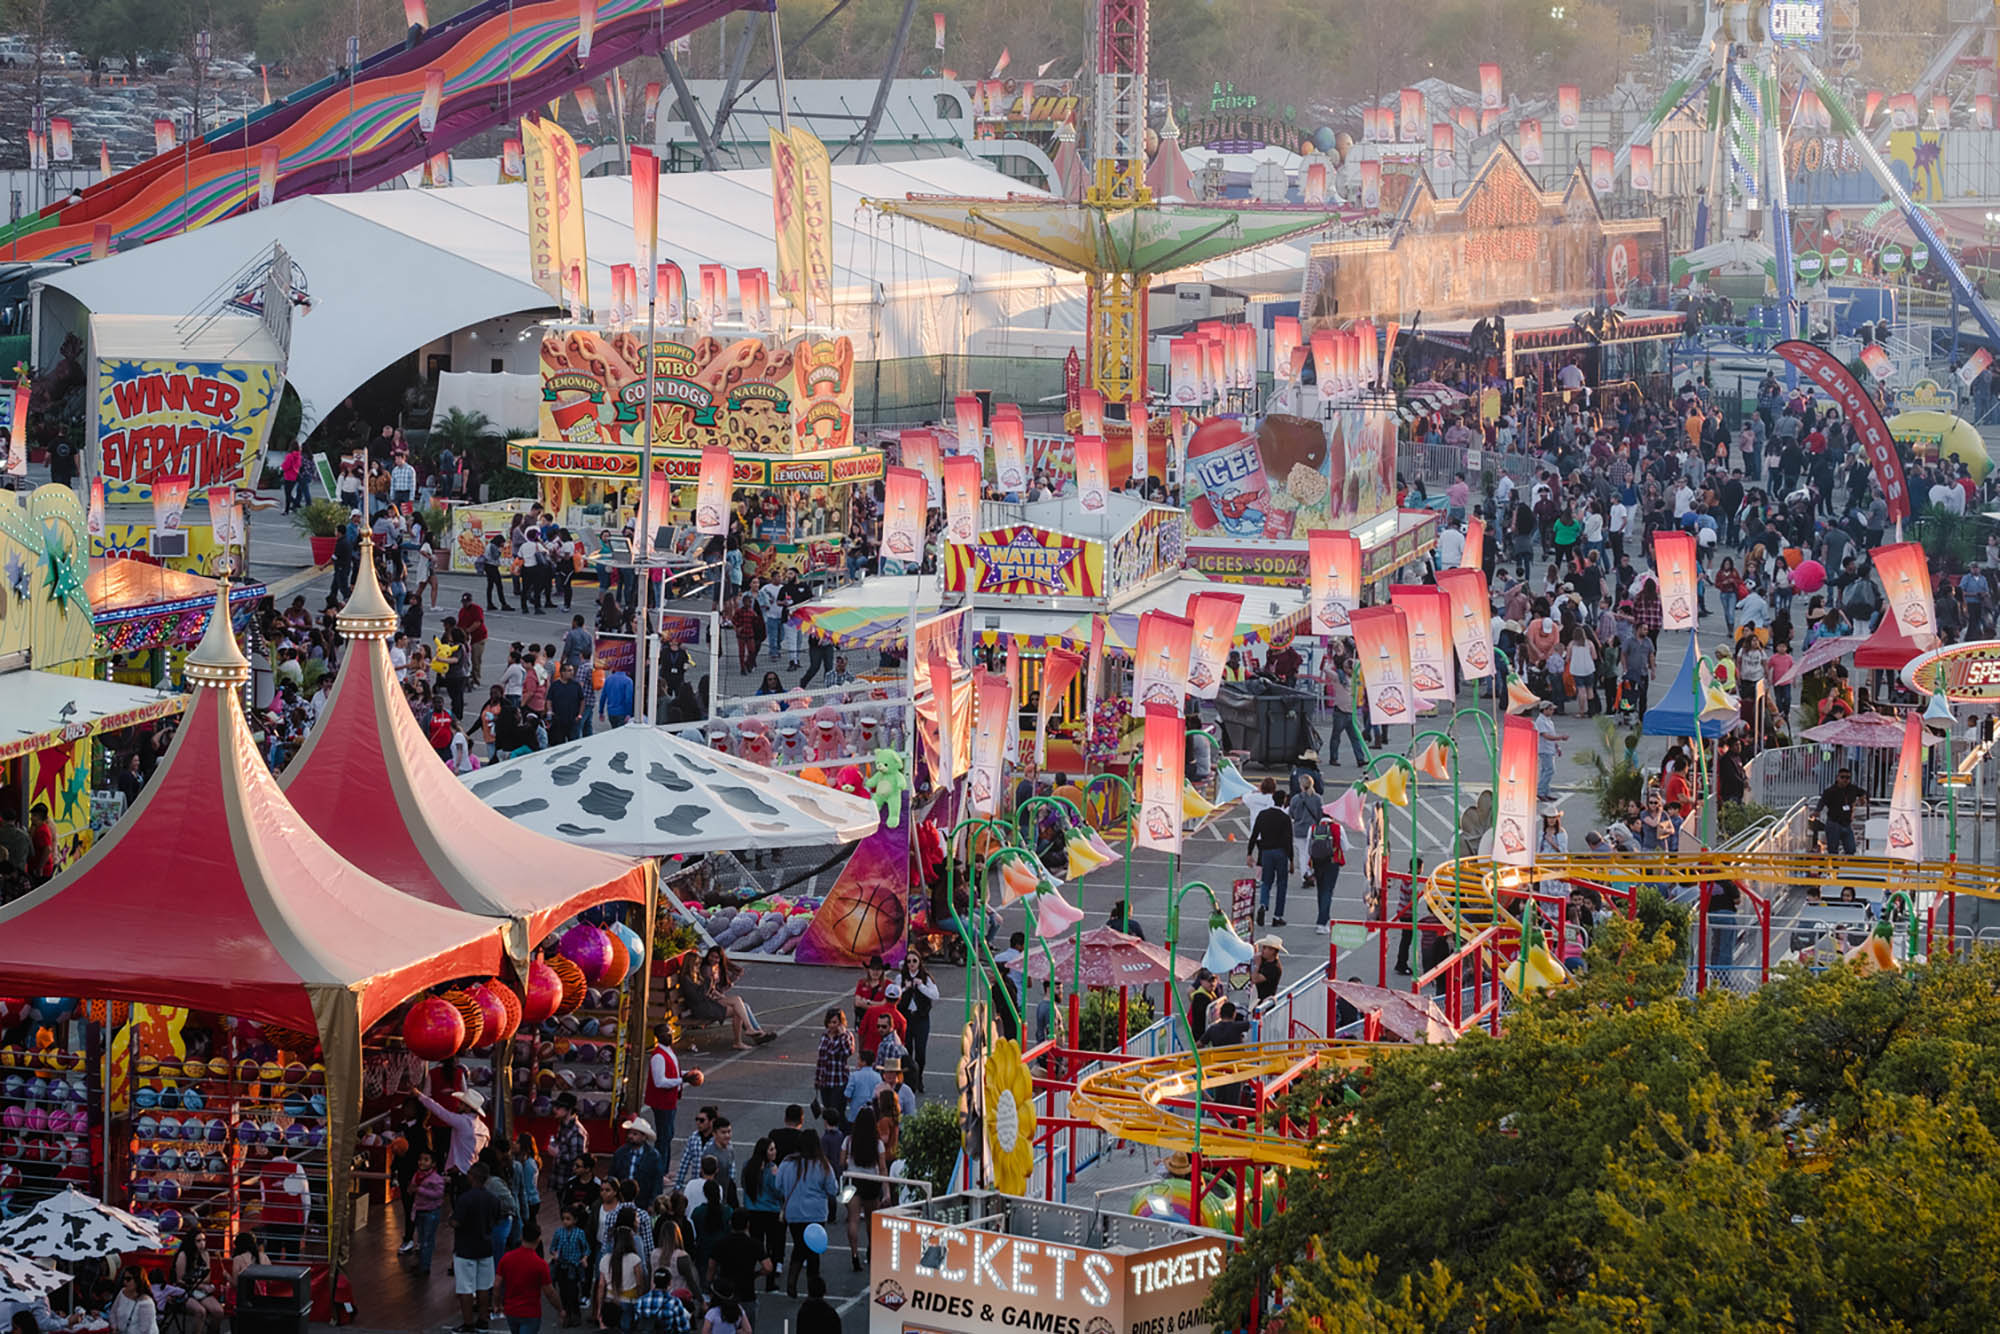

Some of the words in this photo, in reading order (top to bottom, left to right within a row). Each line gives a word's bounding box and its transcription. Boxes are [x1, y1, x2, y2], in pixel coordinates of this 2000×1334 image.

[533, 159, 551, 280] LEMONADE
[803, 168, 827, 290] LEMONADE
[635, 361, 698, 377] JMBO
[549, 376, 600, 392] LEMONADE
[625, 381, 667, 404] CON
[668, 382, 709, 407] DOGS
[733, 386, 785, 402] NACHOS
[112, 374, 241, 422] WINNER
[1818, 364, 1902, 501] RESTROOM
[101, 424, 246, 489] EVERYTIME
[546, 454, 622, 471] JUMBO
[665, 460, 701, 476] COR
[1197, 446, 1260, 489] ICEE
[775, 470, 827, 481] LEMONADE
[990, 548, 1060, 565] WATER
[1200, 555, 1243, 573] ICEES
[1254, 557, 1298, 574] SODA
[998, 565, 1052, 582] FUN
[882, 1217, 1114, 1307] TICKETS
[1131, 1246, 1222, 1296] TICKETS
[911, 1289, 974, 1322] RIDES
[980, 1303, 994, 1322] &
[1001, 1306, 1080, 1334] GAMES
